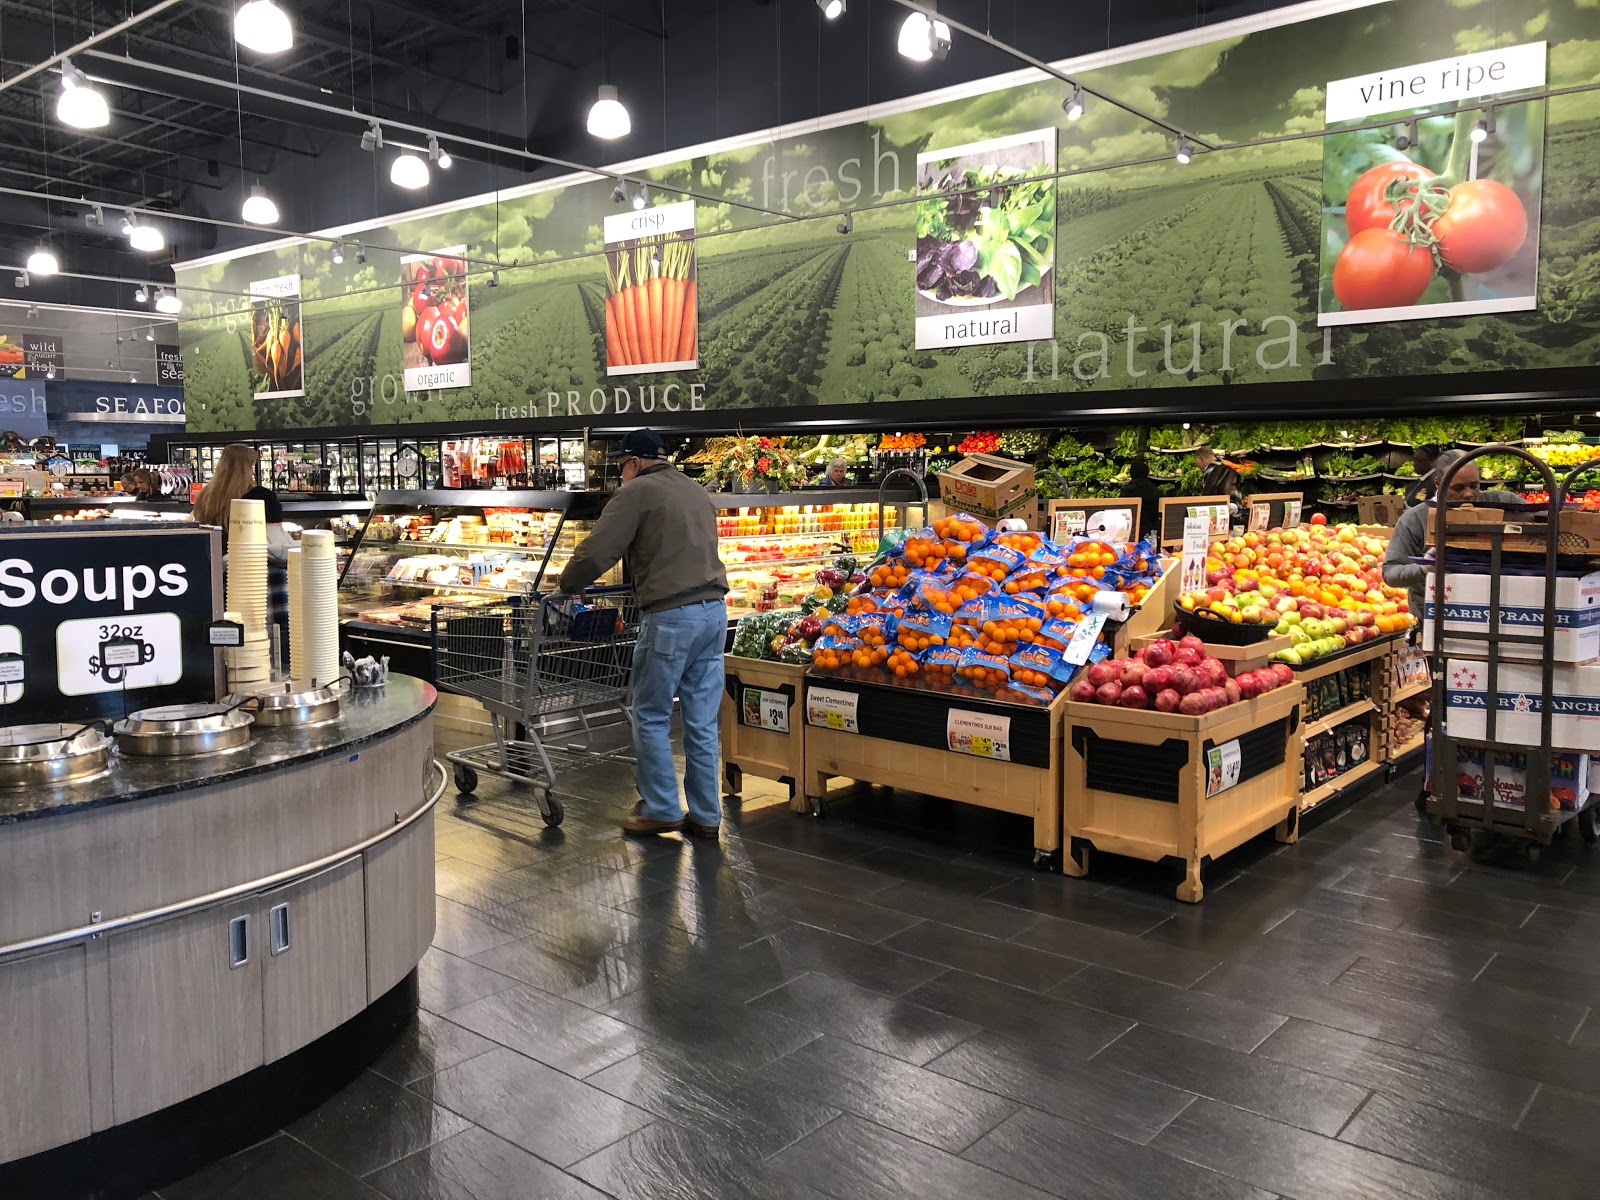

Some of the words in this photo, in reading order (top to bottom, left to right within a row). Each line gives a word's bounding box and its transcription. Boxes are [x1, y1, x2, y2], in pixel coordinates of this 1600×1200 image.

[1360, 76, 1426, 104] vine
[1441, 61, 1506, 91] ripe
[760, 130, 902, 216] fresh
[631, 212, 665, 230] crisp
[944, 312, 1019, 340] natural
[30, 342, 56, 352] wild
[31, 352, 56, 360] AUGHT
[417, 369, 455, 387] organic
[96, 396, 185, 415] SEAFO
[495, 400, 538, 420] fresh
[547, 384, 706, 417] PRODUCE
[955, 480, 977, 494] Dole
[949, 500, 987, 514] BANANAS
[0, 558, 189, 611] Soups
[1428, 607, 1482, 619] SARR
[1506, 612, 1570, 624] RANH
[99, 624, 143, 640] 32oz
[1019, 650, 1052, 666] halos
[810, 694, 825, 703] Sweet
[825, 696, 855, 708] Clementines
[1452, 695, 1509, 707] STAR
[954, 719, 984, 729] CLEMENTINES
